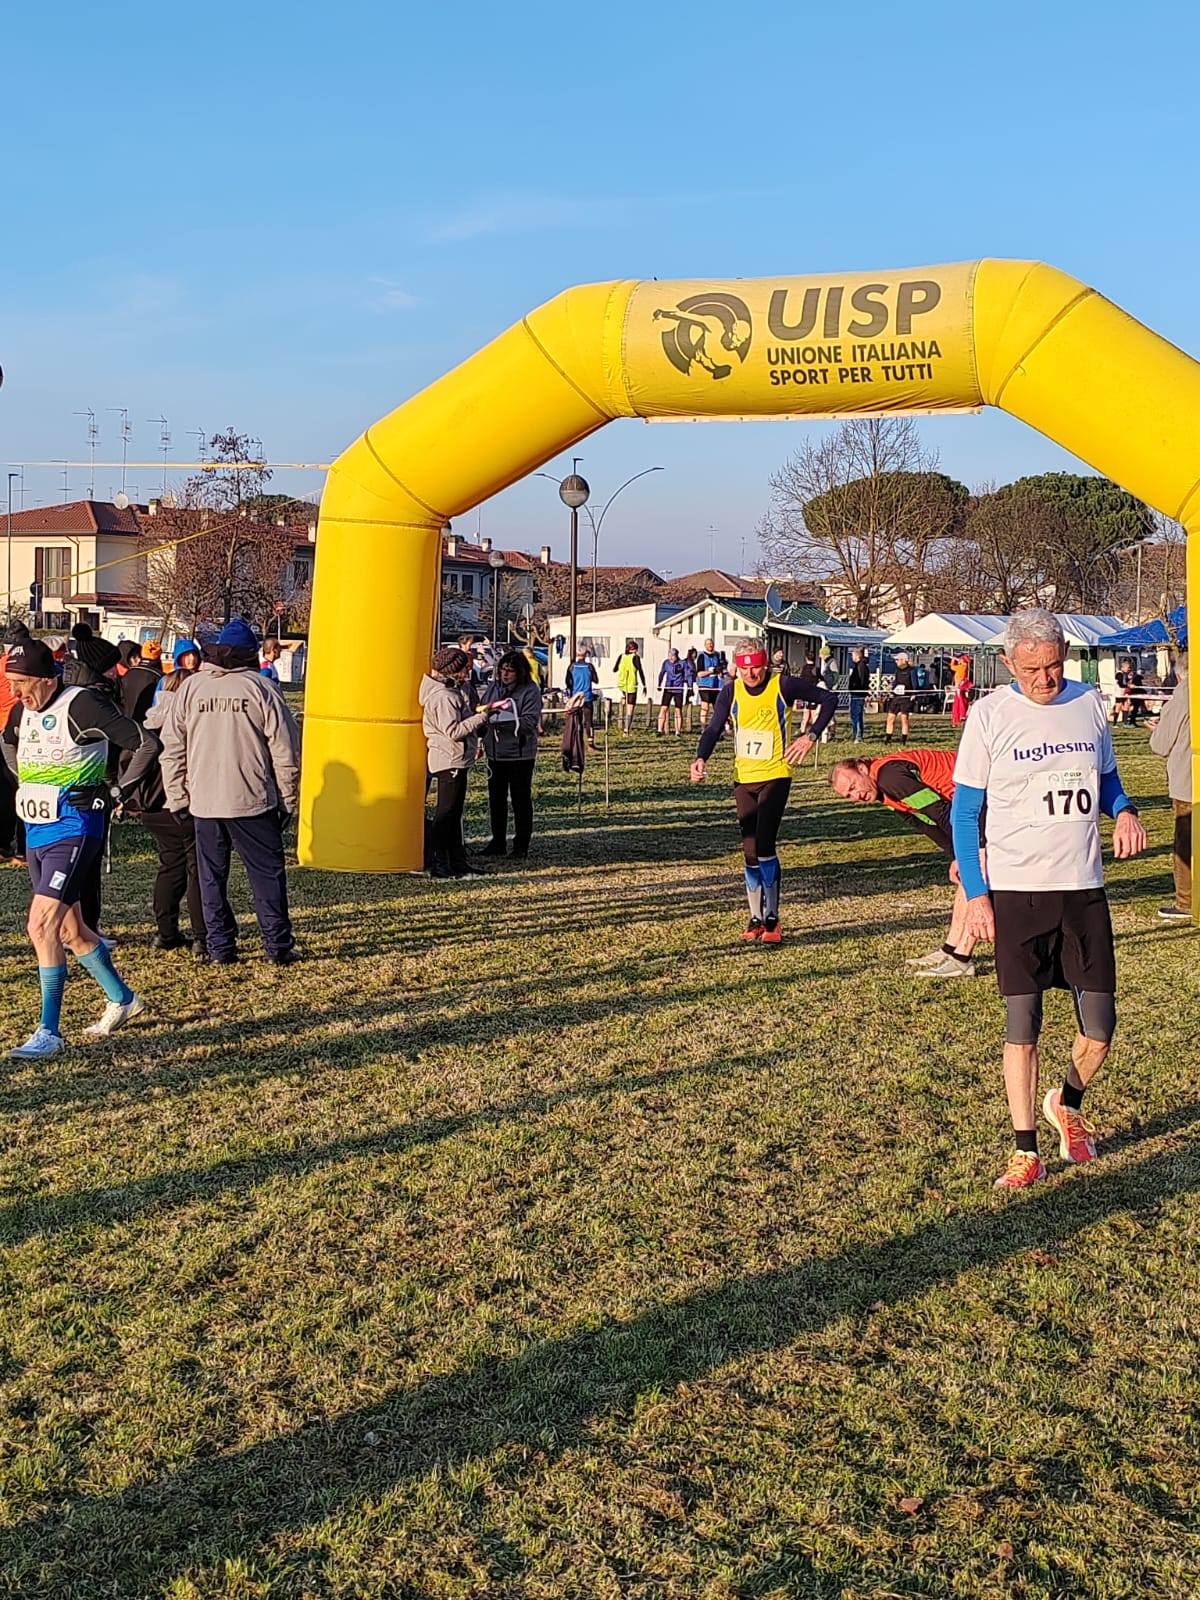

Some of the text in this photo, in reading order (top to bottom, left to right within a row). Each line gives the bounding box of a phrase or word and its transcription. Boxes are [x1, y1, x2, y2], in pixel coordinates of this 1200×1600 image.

[767, 280, 941, 341] UISP
[767, 340, 942, 365] UNIONE ITALIANA
[769, 363, 933, 386] SPORT PER TUTTI
[746, 741, 763, 755] 17
[1013, 742, 1096, 762] lughesina
[20, 798, 51, 819] 108
[1042, 788, 1092, 816] 170
